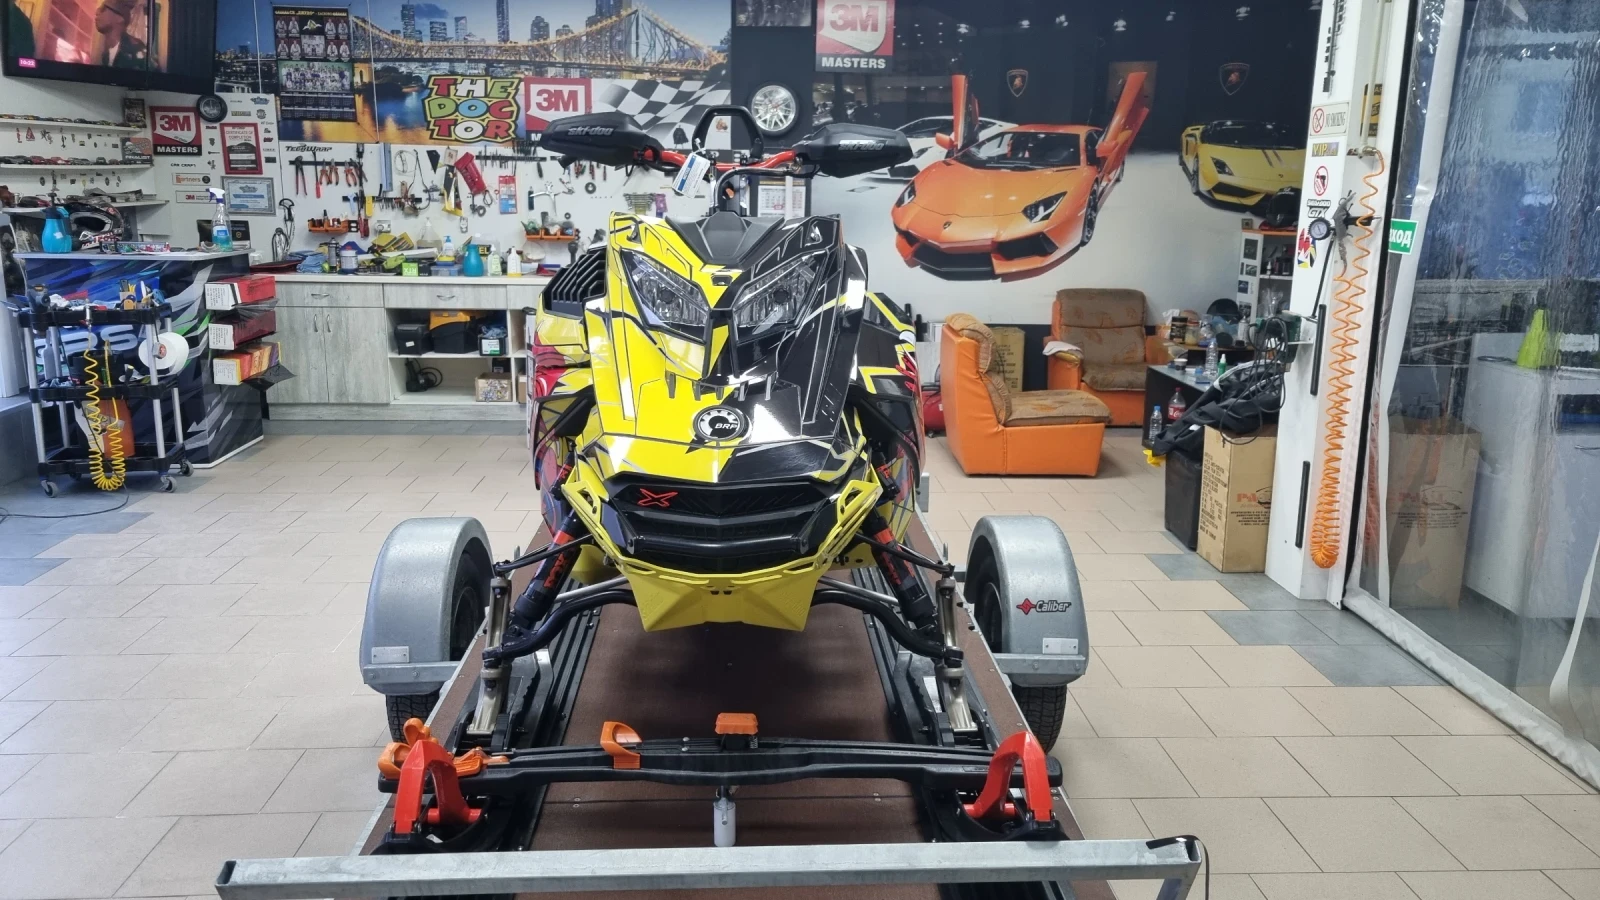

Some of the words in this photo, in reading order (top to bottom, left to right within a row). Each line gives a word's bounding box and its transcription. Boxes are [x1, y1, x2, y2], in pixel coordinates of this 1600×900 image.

[829, 2, 879, 33] 3M
[821, 57, 887, 69] MASTERS
[431, 77, 513, 99] THE
[535, 88, 579, 112] 3M
[159, 114, 192, 132] 3M
[567, 126, 614, 136] ski-doo
[1308, 207, 1328, 218] GTX
[714, 422, 739, 430] BRP
[1036, 599, 1072, 612] Caliber
